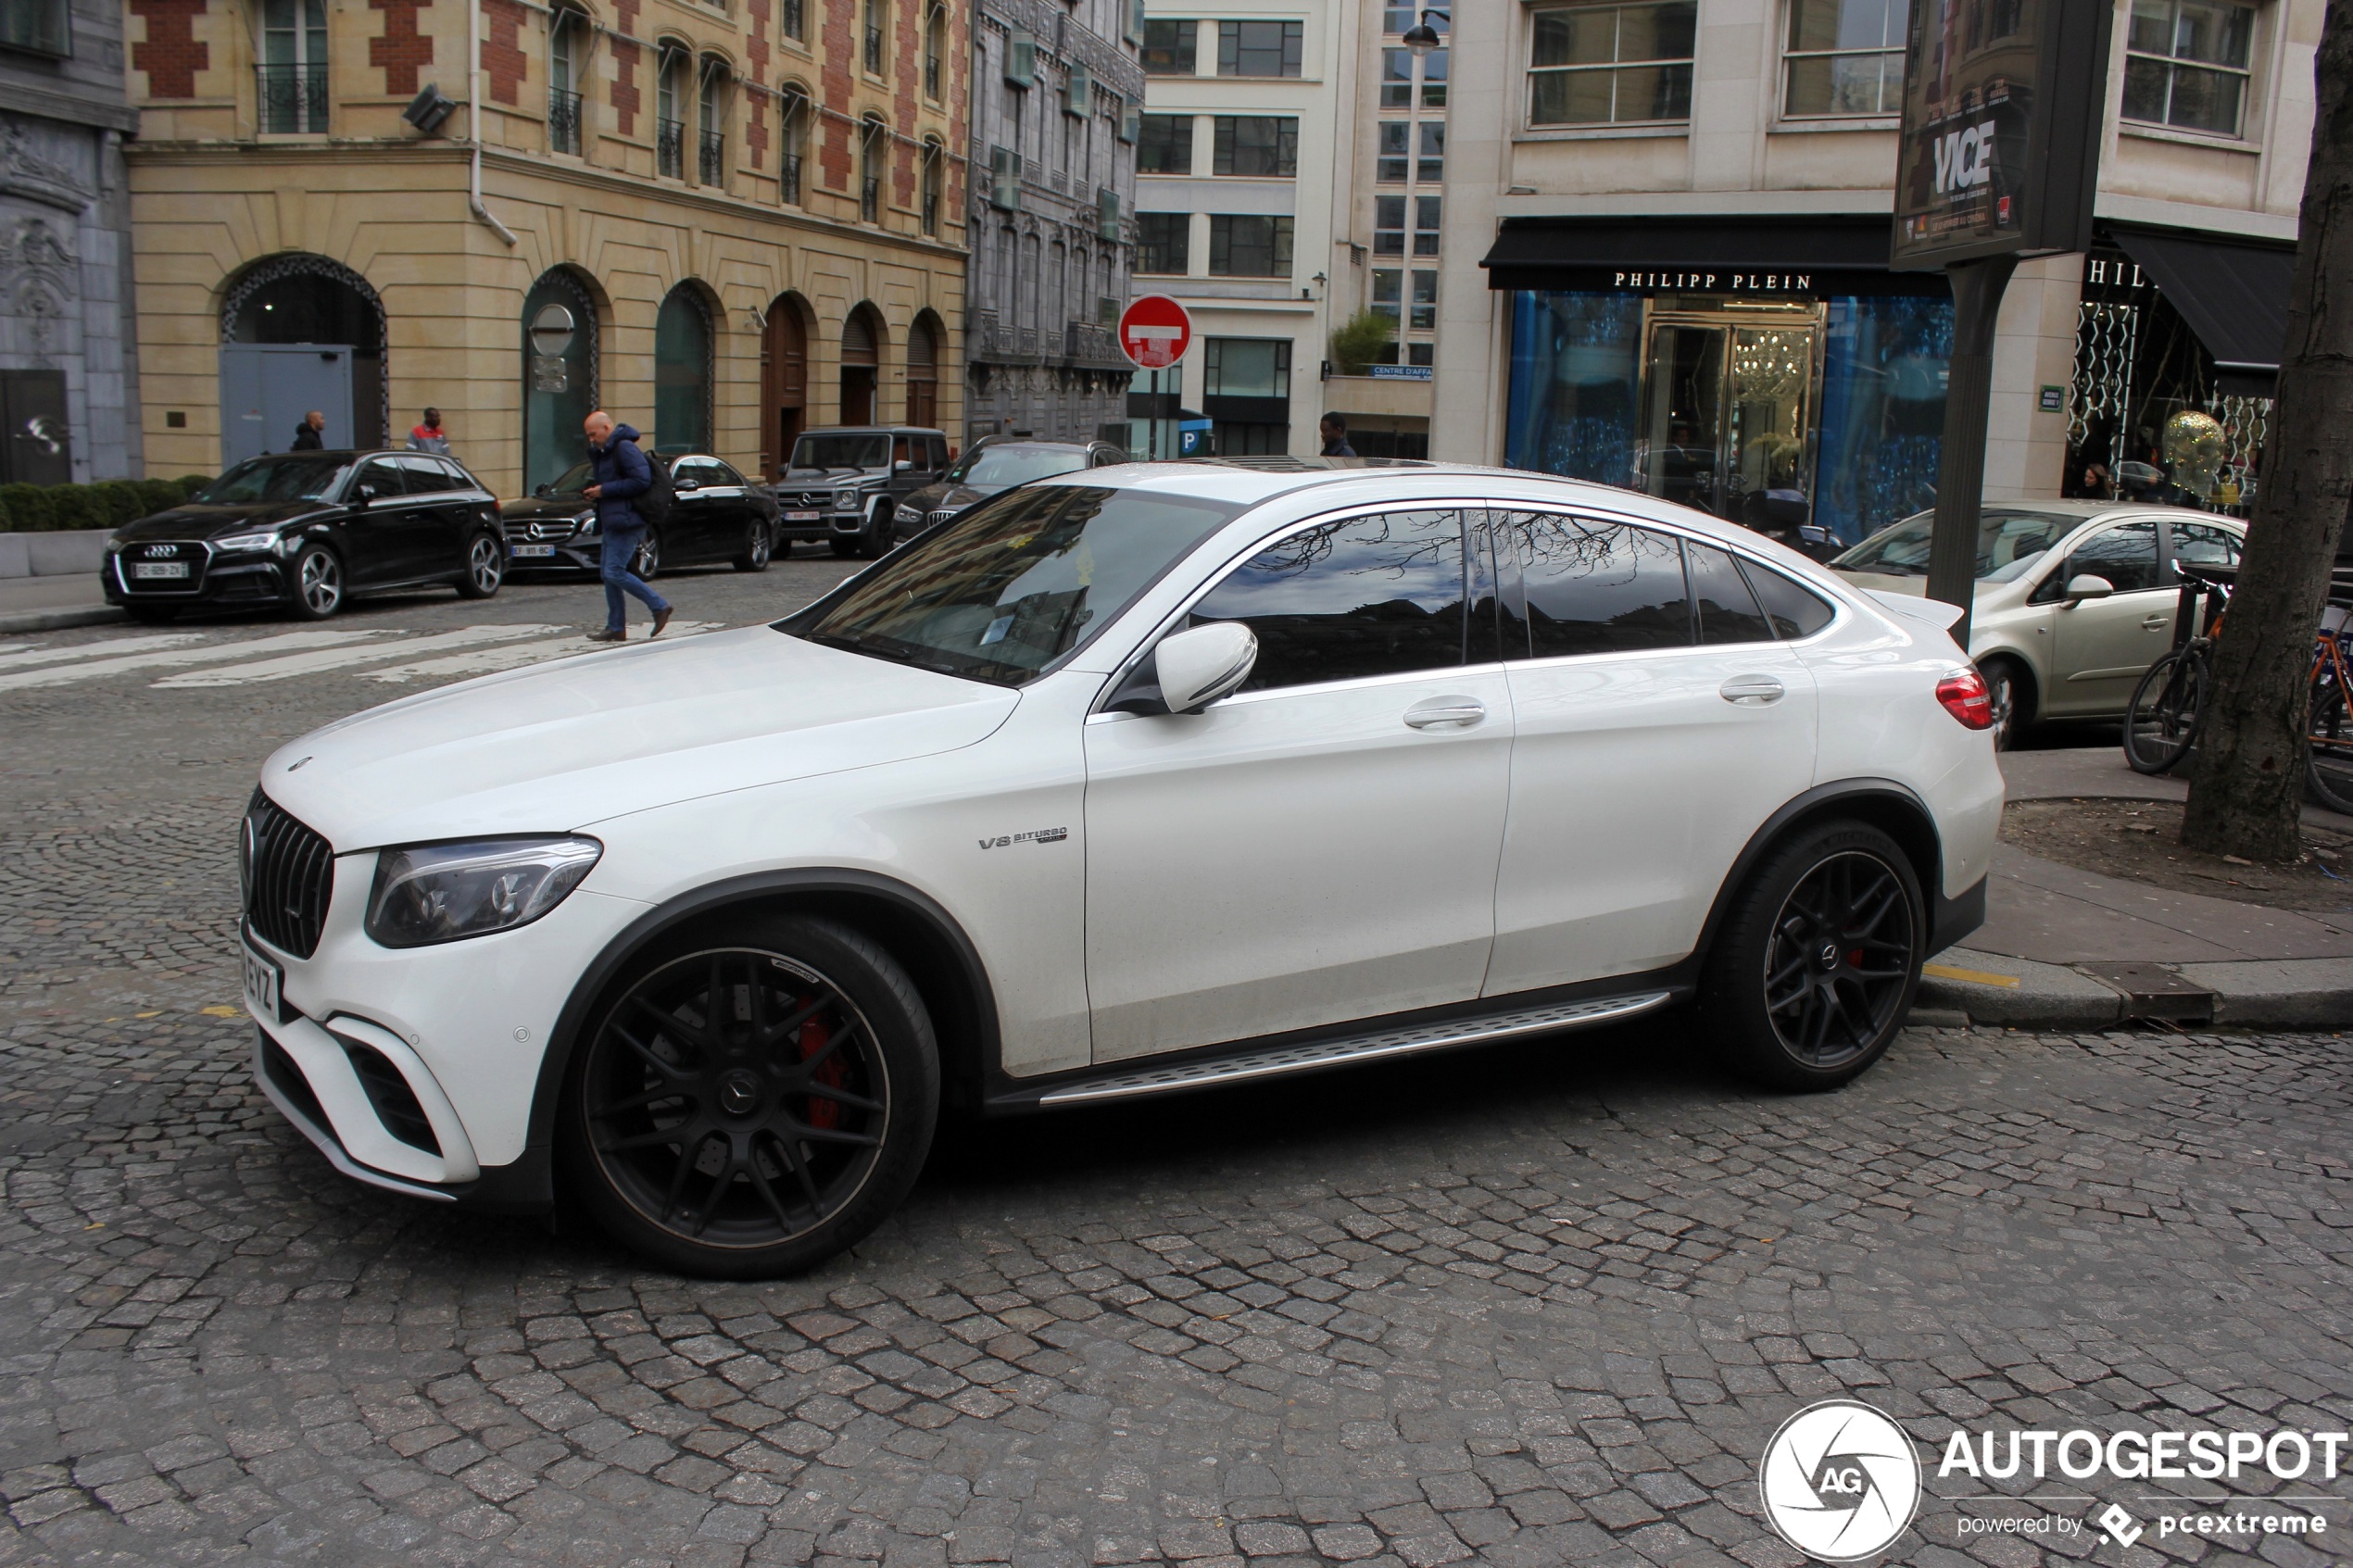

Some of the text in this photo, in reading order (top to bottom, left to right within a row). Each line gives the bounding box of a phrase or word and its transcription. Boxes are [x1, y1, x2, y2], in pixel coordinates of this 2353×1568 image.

[1934, 119, 1995, 194] VICE
[1615, 272, 1810, 289] PHILIPP PLEIN
[2089, 260, 2159, 289] HIL
[1184, 433, 1195, 449] P
[978, 827, 1068, 849] V8 BITURBO
